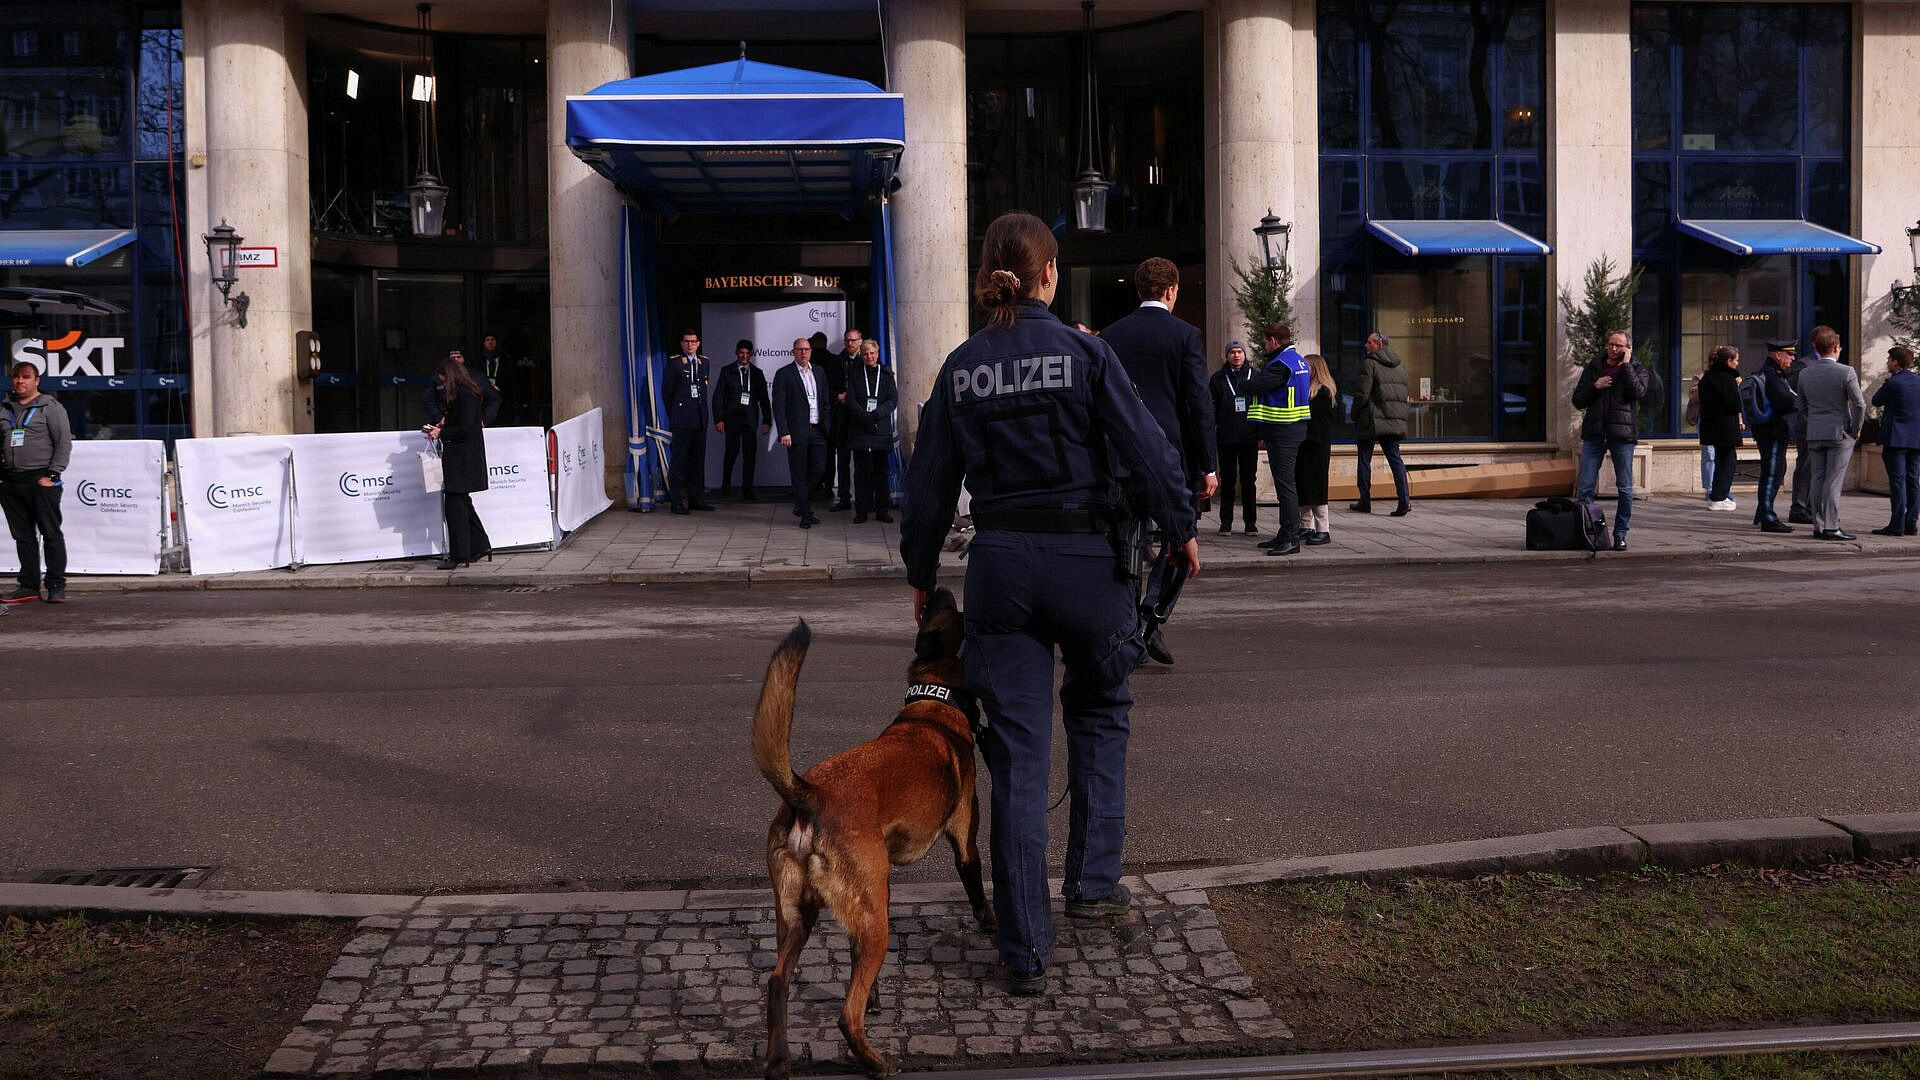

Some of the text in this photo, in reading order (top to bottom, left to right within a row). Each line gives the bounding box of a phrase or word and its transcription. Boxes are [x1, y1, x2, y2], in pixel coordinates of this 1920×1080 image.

[705, 275, 841, 289] BAYERISCHER HOF
[820, 310, 837, 318] msc
[953, 355, 1072, 402] POLIZEI
[490, 464, 519, 476] msc
[363, 475, 393, 487] msc
[101, 488, 132, 498] msc
[231, 486, 263, 499] msc
[906, 684, 951, 700] POLIZEI
